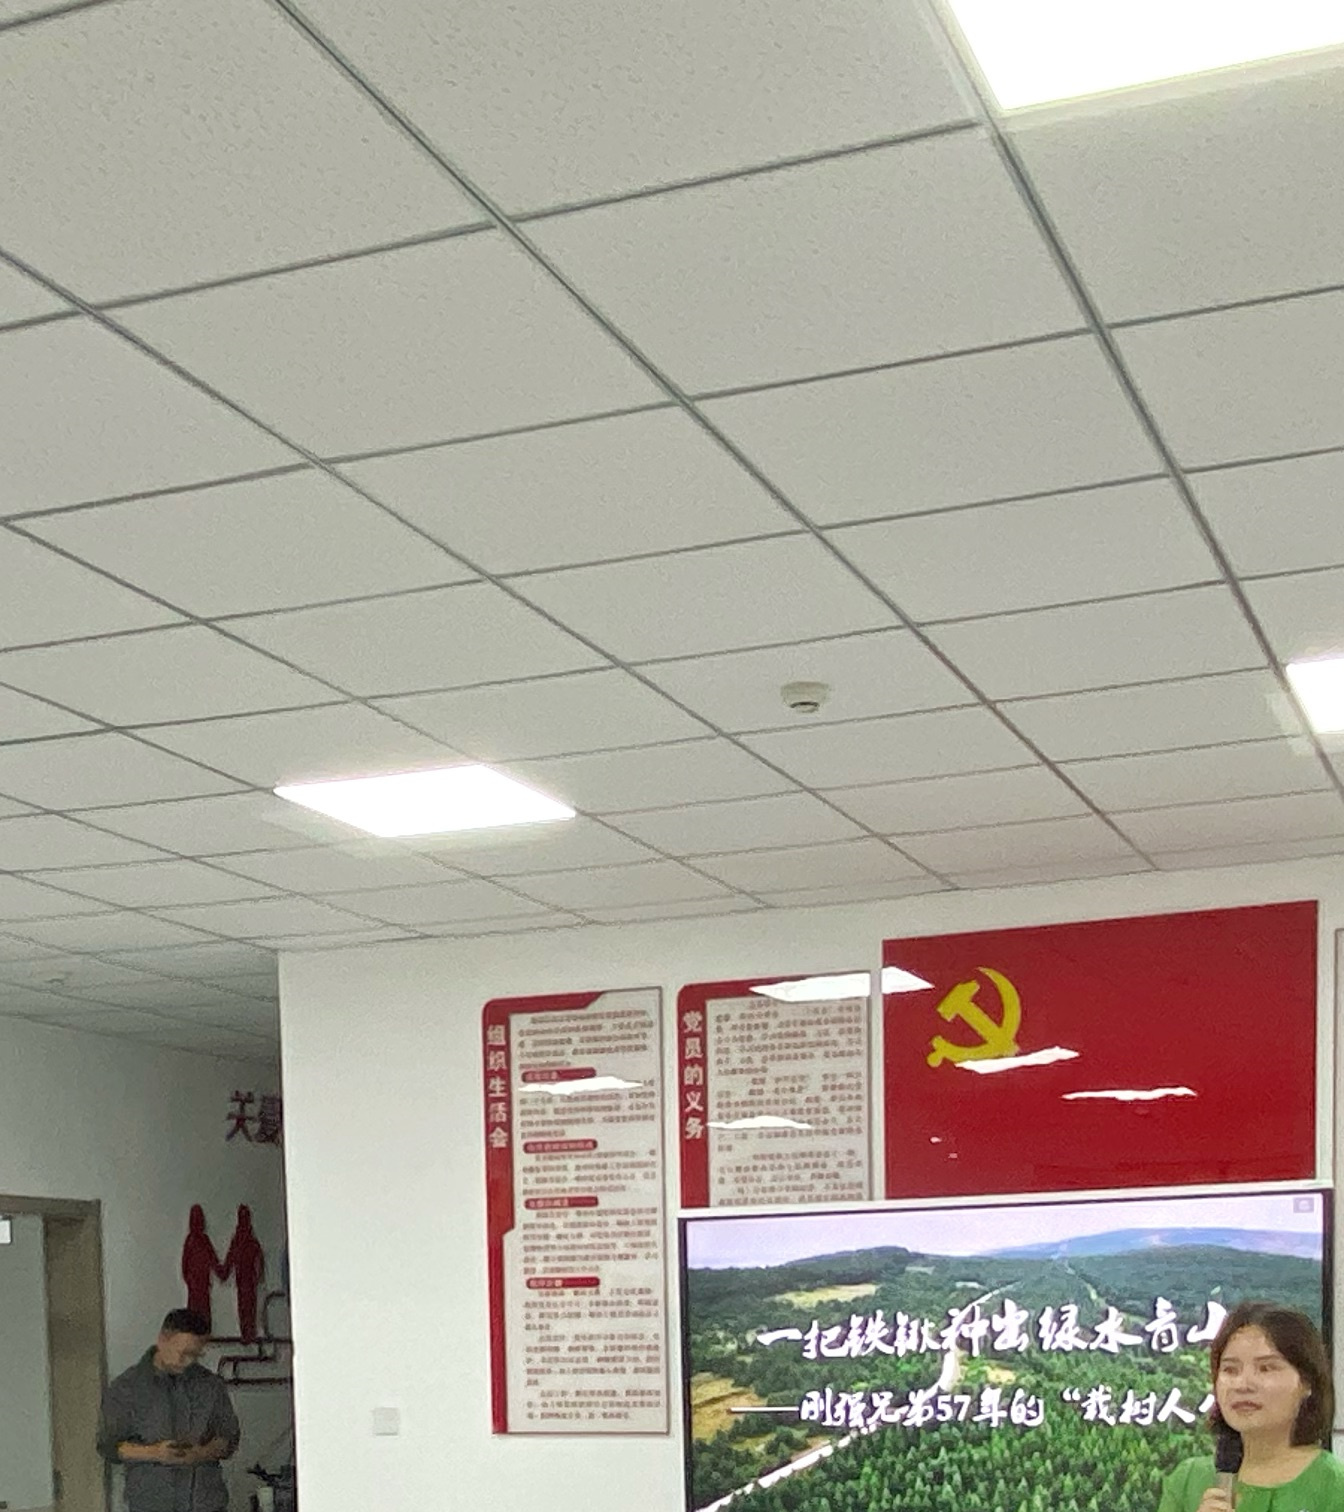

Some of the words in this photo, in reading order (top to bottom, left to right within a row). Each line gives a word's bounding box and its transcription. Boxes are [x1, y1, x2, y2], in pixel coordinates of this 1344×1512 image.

[487, 1024, 508, 1148] 组织生活会
[683, 1010, 704, 1140] 党员的义务
